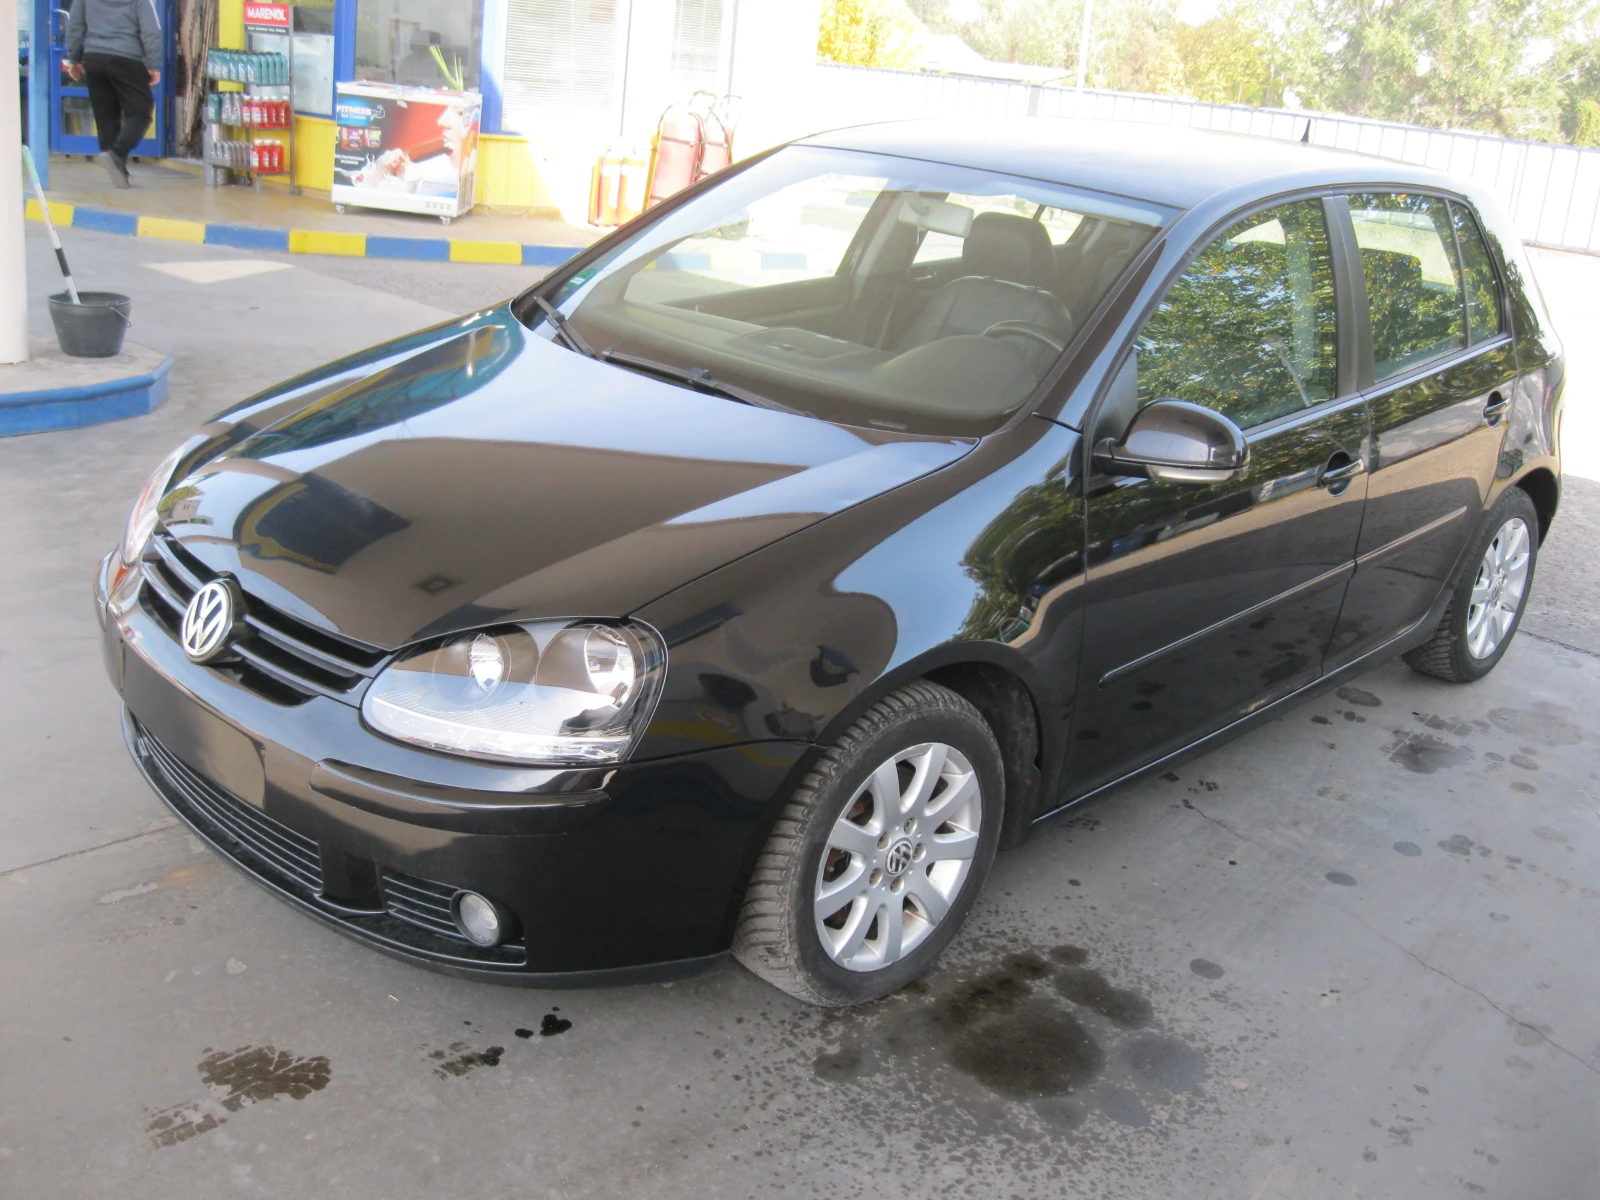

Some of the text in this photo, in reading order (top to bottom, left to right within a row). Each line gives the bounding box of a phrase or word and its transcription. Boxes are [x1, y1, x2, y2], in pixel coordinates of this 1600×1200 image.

[247, 7, 286, 21] MARENOL
[337, 105, 372, 115] FITNESS
[183, 583, 228, 656] VW
